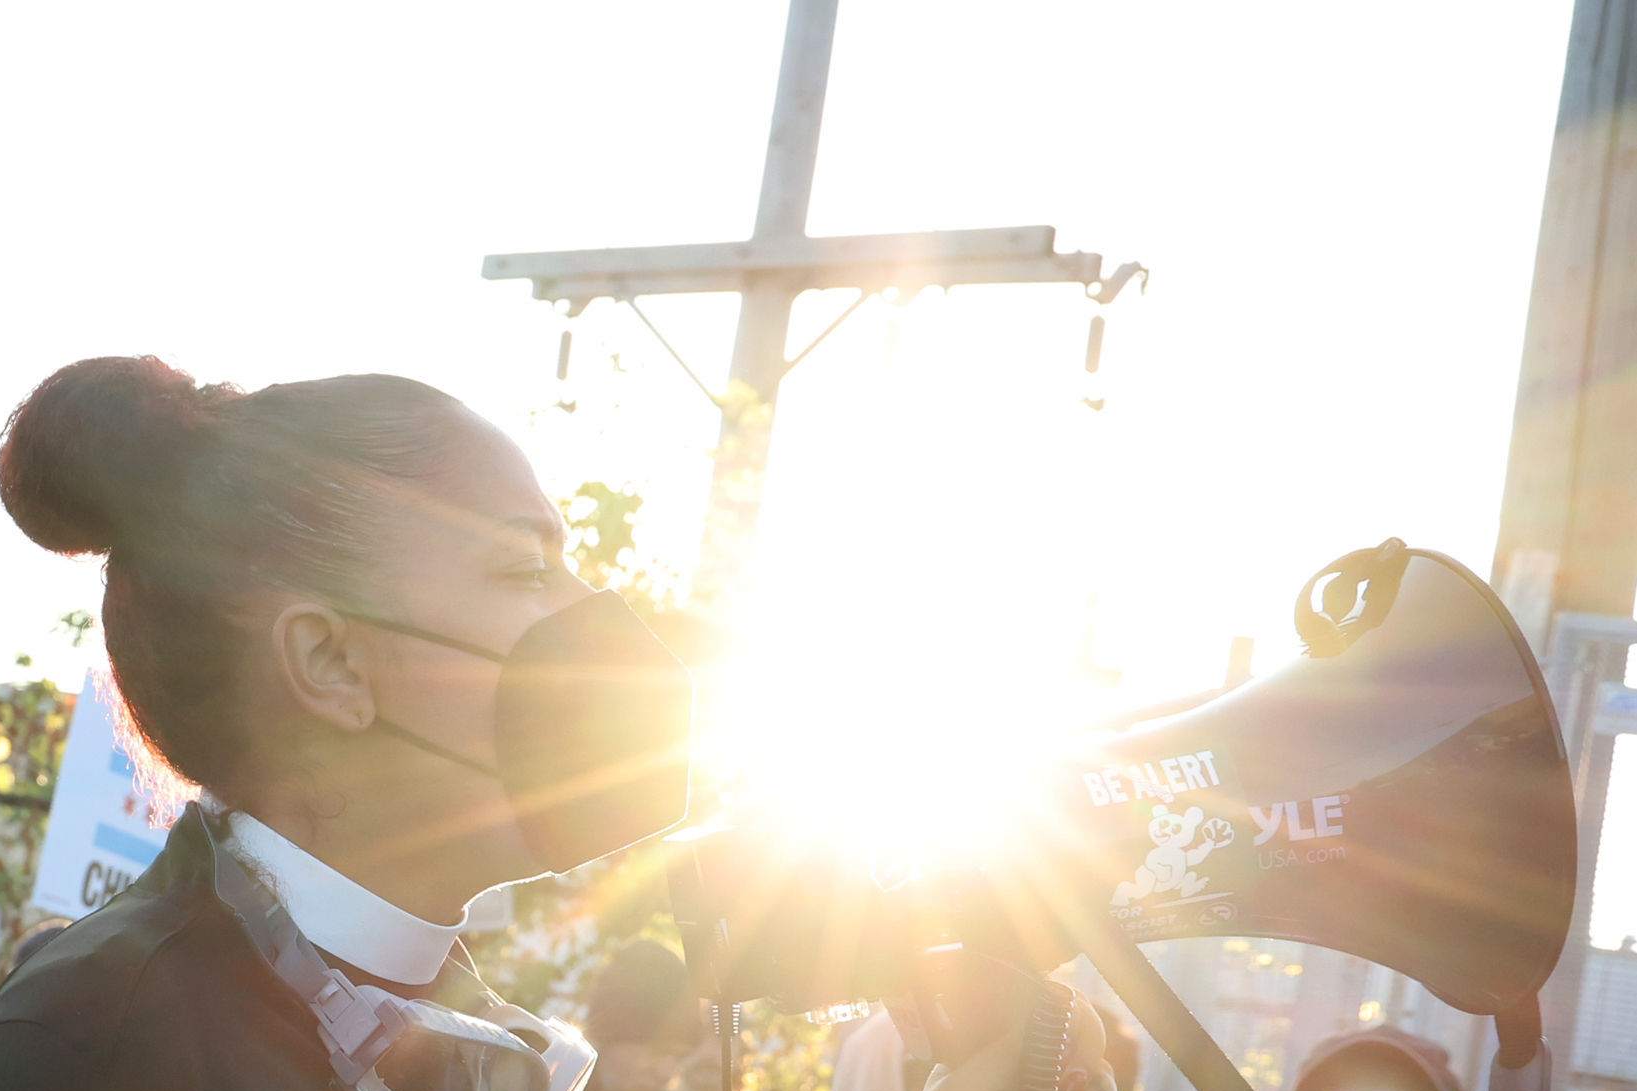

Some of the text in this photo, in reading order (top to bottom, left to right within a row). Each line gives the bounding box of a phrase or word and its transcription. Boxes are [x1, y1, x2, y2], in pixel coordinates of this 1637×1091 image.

[1082, 750, 1221, 807] BE ALERT
[1248, 795, 1344, 846] YLE
[1120, 914, 1177, 931] SCIST
